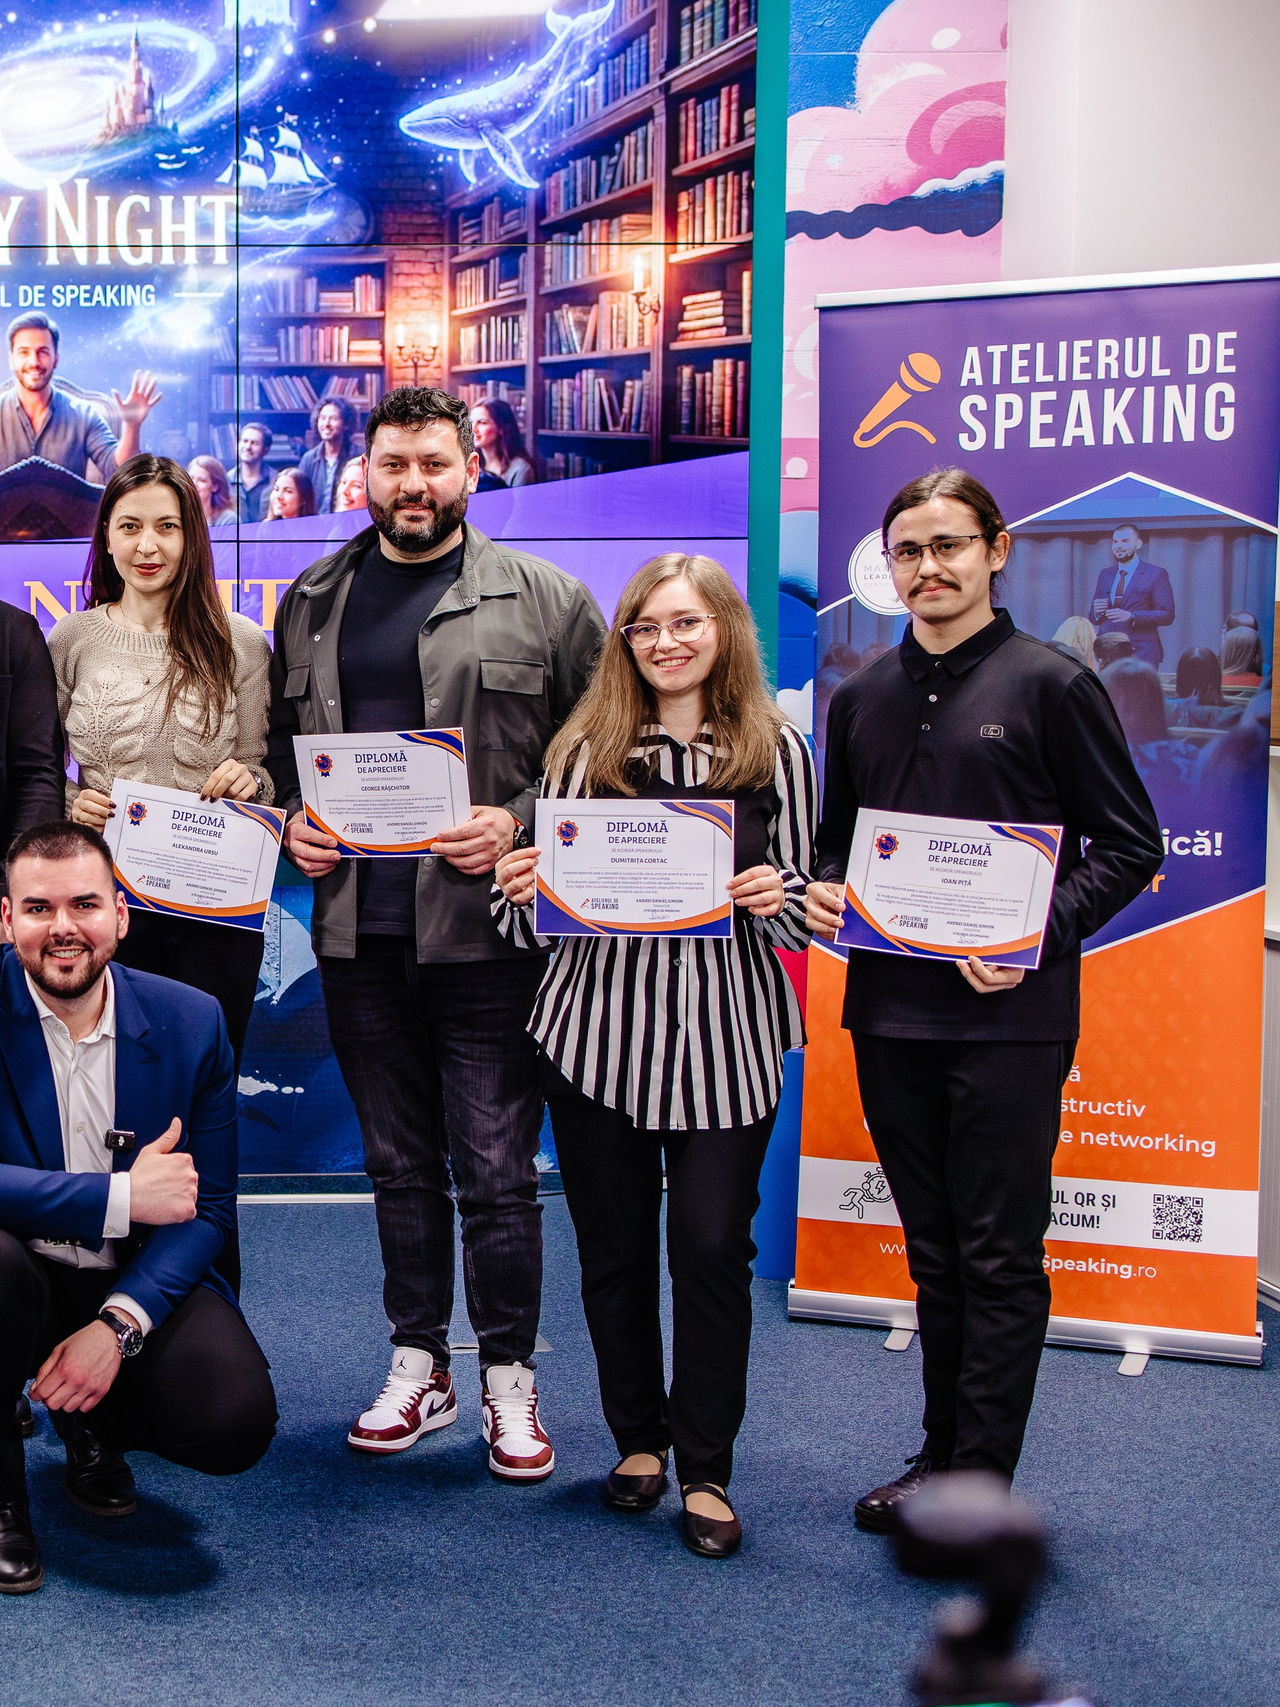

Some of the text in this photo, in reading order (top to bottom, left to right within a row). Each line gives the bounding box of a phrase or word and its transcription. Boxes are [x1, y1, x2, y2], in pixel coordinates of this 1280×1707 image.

[20, 286, 46, 307] DE
[51, 284, 156, 307] SPEAKING
[960, 331, 1238, 387] ATELIERUL DE
[958, 382, 1236, 451] SPEAKING
[354, 750, 407, 764] DIPLOMĂ
[368, 765, 407, 773] APRECIERE
[171, 809, 226, 829] DIPLOMĂ
[182, 825, 223, 839] APRECIERE
[606, 820, 669, 833] DIPLOMĂ
[608, 836, 620, 844] DE
[1161, 828, 1223, 857] ică!
[171, 843, 218, 856] ALEXANDRA URSU
[928, 839, 992, 857] DIPLOMĂ
[611, 857, 644, 865] DUMITRIȚA
[928, 854, 989, 867] DE APRECIERE
[146, 880, 171, 890] SPEAKING
[958, 879, 972, 888] PIȚĂ
[899, 919, 928, 930] SPEAKING
[1060, 1097, 1146, 1118] structiv
[1060, 1130, 1216, 1158] e networking
[1051, 1190, 1116, 1212] UL QR ȘI
[1042, 1254, 1157, 1279] Speaking.ro
